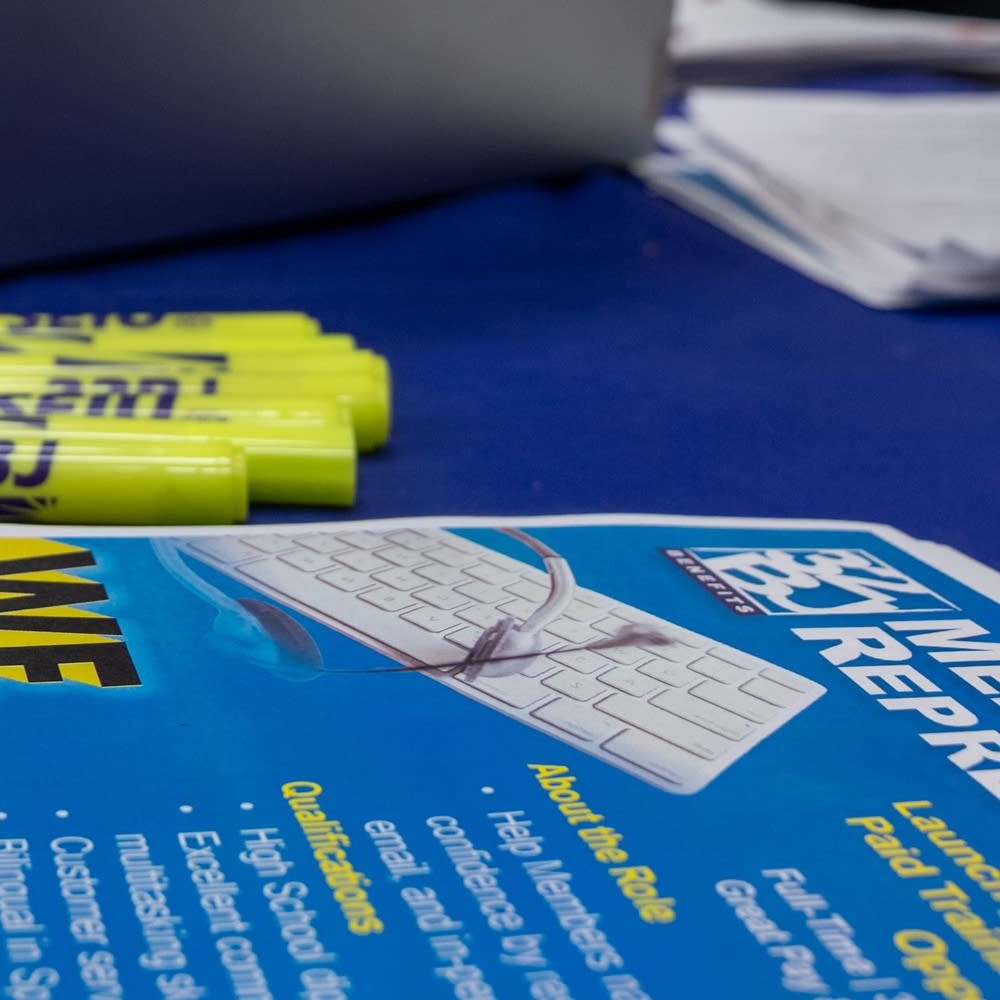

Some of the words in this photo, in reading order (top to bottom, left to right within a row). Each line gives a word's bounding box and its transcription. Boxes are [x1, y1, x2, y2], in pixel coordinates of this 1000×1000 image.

[664, 549, 756, 614] BENEFITS
[50, 836, 110, 945] Customer
[177, 831, 250, 934] Excellent
[239, 827, 294, 877] High
[281, 781, 384, 935] Qualifications
[426, 815, 525, 931] confidence
[500, 933, 547, 968] by
[487, 810, 544, 857] Help
[522, 860, 625, 972] Members
[527, 763, 605, 825] About
[577, 826, 629, 863] the
[608, 866, 676, 924] Role
[845, 815, 941, 878] Paid
[6, 936, 51, 963] in
[115, 833, 189, 970] multitasking
[263, 881, 337, 963] School
[401, 887, 464, 932] and
[715, 878, 792, 945] Great
[767, 945, 830, 994] Pay
[761, 867, 877, 977] Full-Time
